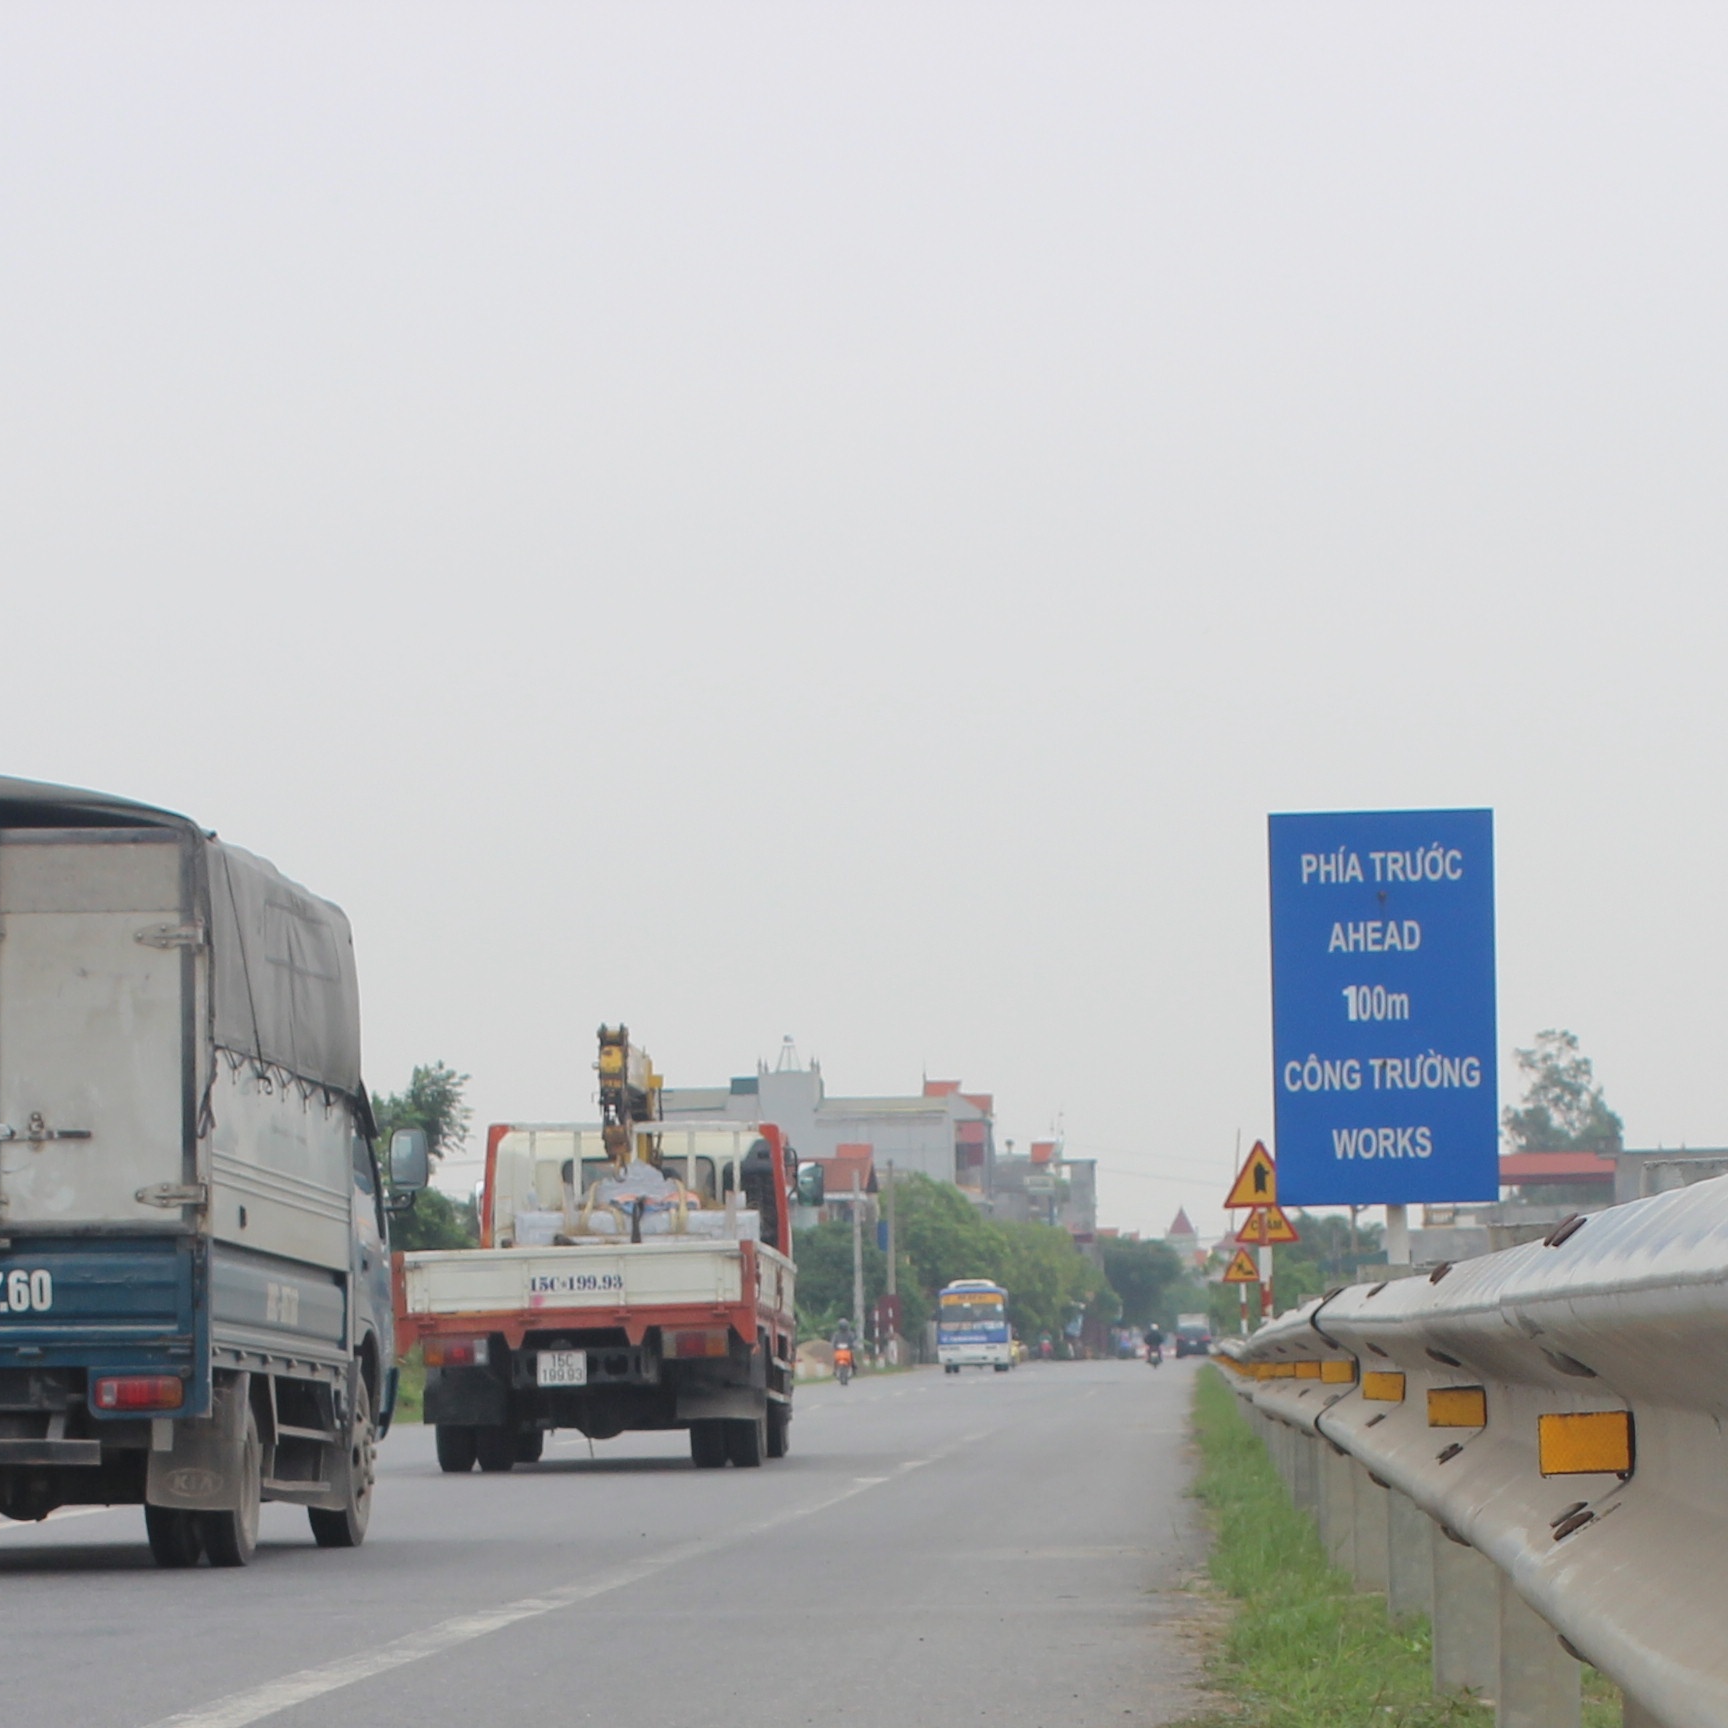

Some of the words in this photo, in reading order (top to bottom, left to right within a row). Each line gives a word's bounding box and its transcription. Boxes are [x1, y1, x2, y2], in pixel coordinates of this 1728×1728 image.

[1301, 845, 1364, 884] PHÍA
[1369, 841, 1463, 882] TRƯỚC
[1328, 919, 1421, 953] AHEAD
[1342, 984, 1410, 1021] 100m
[1284, 1053, 1362, 1092] CÔNG
[1368, 1048, 1481, 1090] TRƯỜNG
[1332, 1126, 1433, 1160] WORKS
[552, 1353, 574, 1368] 15C
